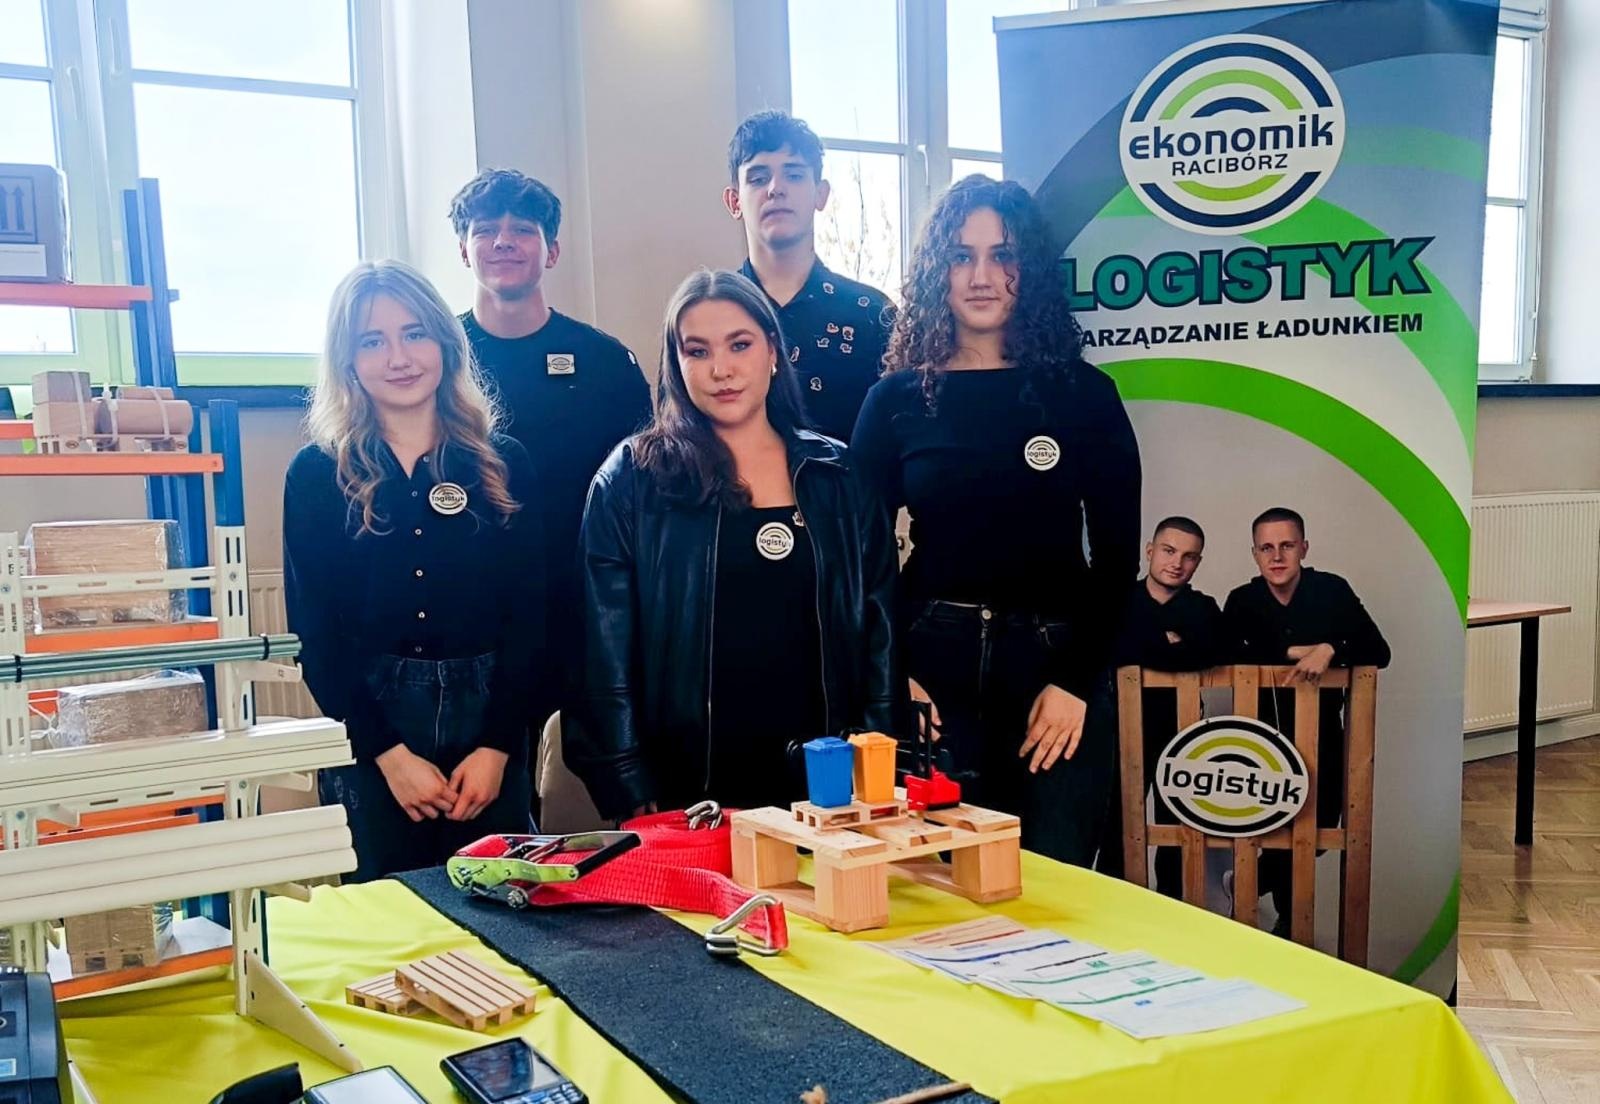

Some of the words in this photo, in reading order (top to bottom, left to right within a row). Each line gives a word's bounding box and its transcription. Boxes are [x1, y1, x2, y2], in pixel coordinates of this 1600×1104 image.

[1129, 113, 1334, 160] ekonomik
[1171, 152, 1288, 176] RACIBÓRZ
[1059, 236, 1436, 312] LOGISTYK
[1080, 322, 1249, 349] ARZĄDZANIE
[1257, 313, 1423, 339] ŁADUNKIEM
[759, 537, 791, 548] logisty
[1163, 763, 1301, 805] logistyk
